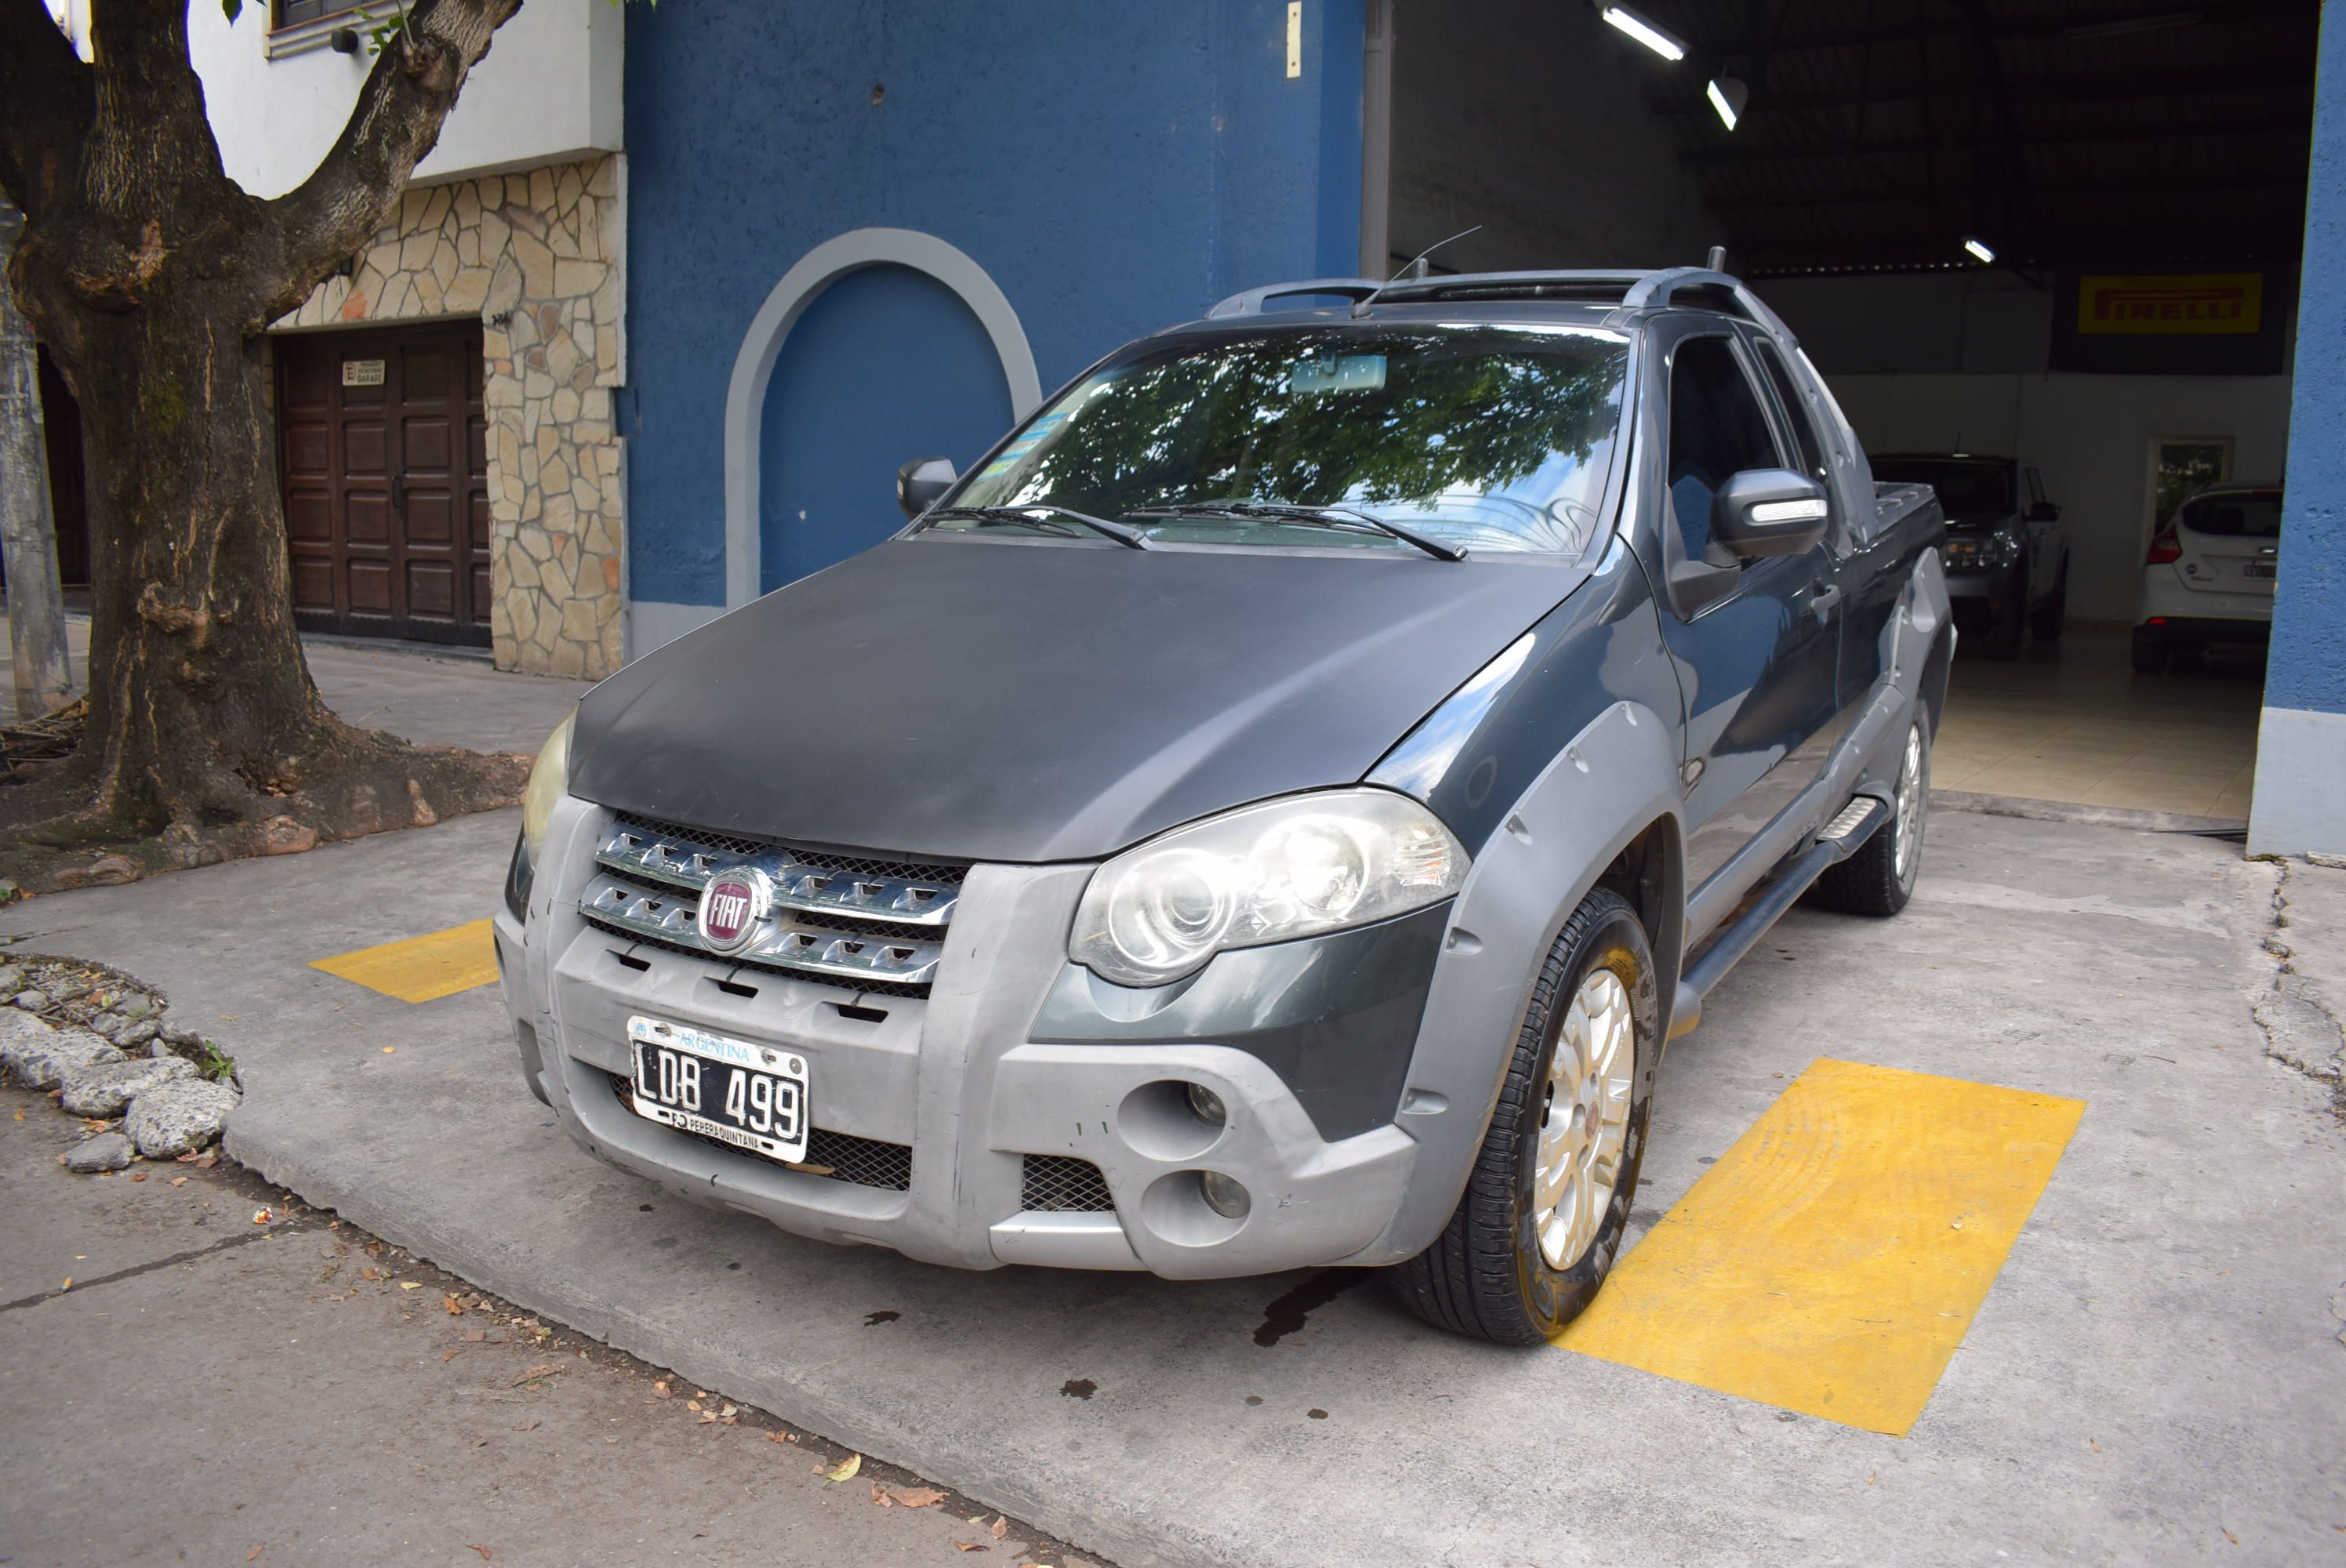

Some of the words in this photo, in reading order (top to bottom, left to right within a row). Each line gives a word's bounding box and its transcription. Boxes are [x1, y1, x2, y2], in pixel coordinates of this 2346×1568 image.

[2094, 288, 2245, 320] PIRELLI
[358, 373, 382, 383] GARAGE
[708, 894, 747, 929] FIAT
[679, 1032, 750, 1062] ARGENTINA
[635, 1043, 701, 1111] LDB
[725, 1069, 799, 1139] 499
